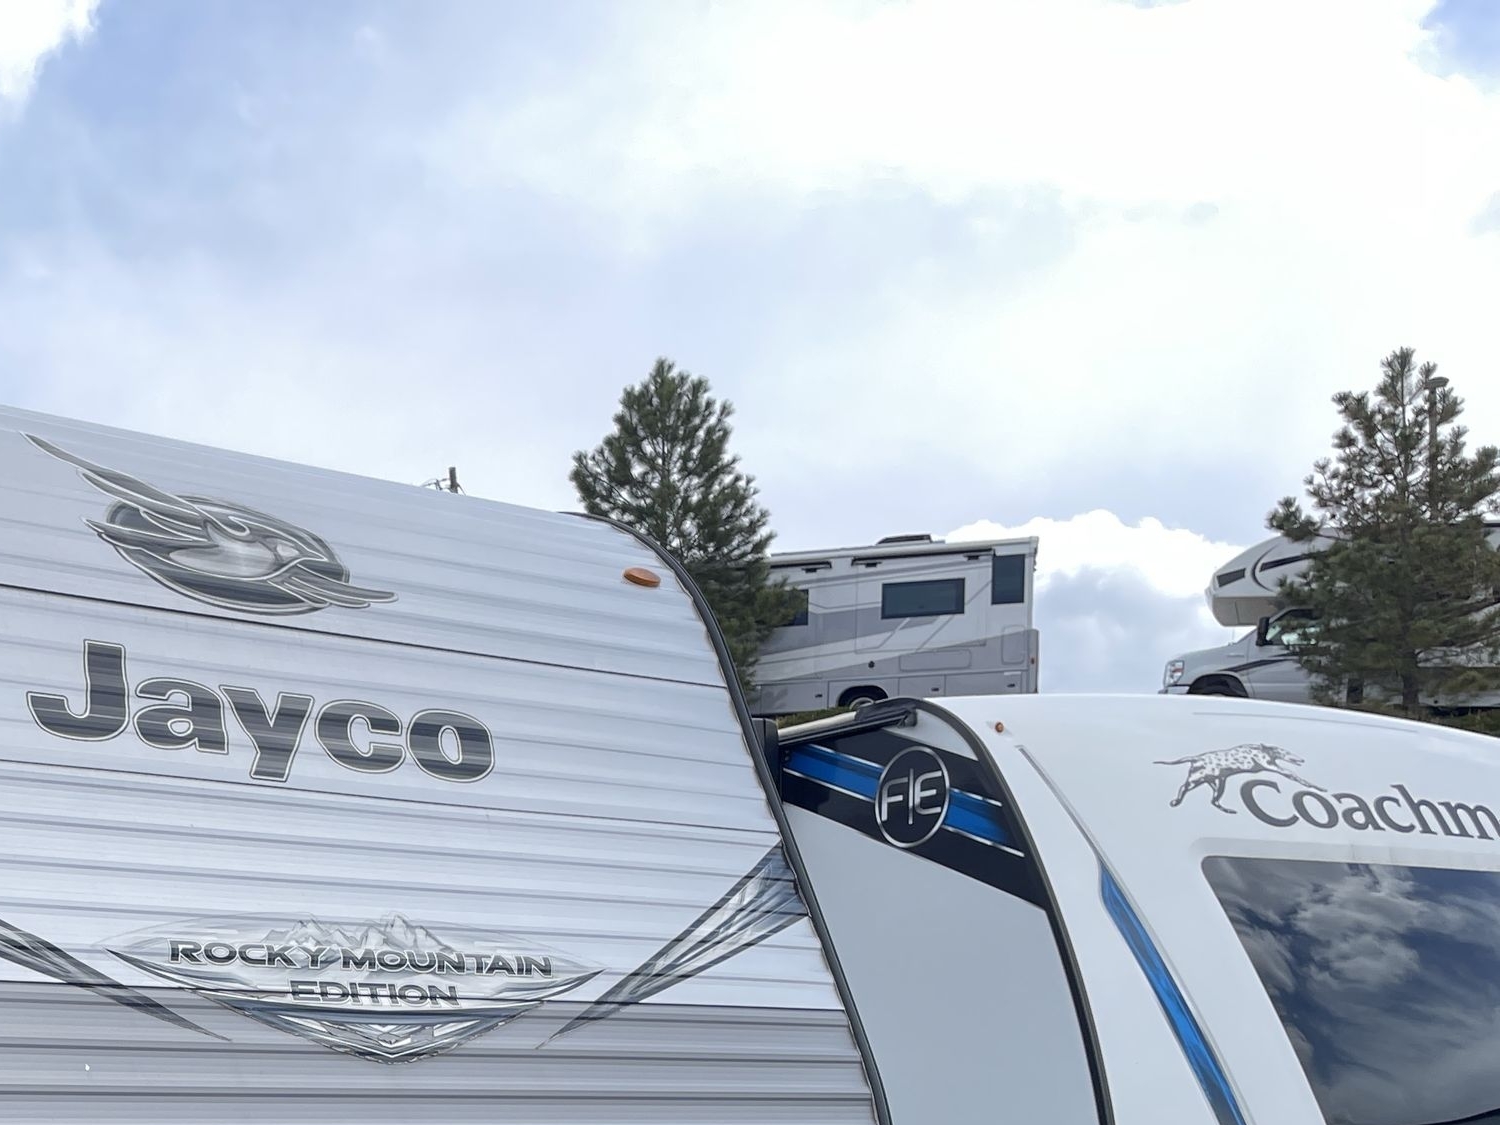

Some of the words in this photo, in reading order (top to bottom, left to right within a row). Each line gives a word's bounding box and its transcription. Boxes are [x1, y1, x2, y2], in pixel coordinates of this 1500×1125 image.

[26, 639, 495, 783] Jayco
[1240, 779, 1500, 840] Coachm
[169, 939, 329, 969] ROCKY
[340, 949, 553, 977] MOUNTAIN
[289, 980, 461, 1007] EDITION
